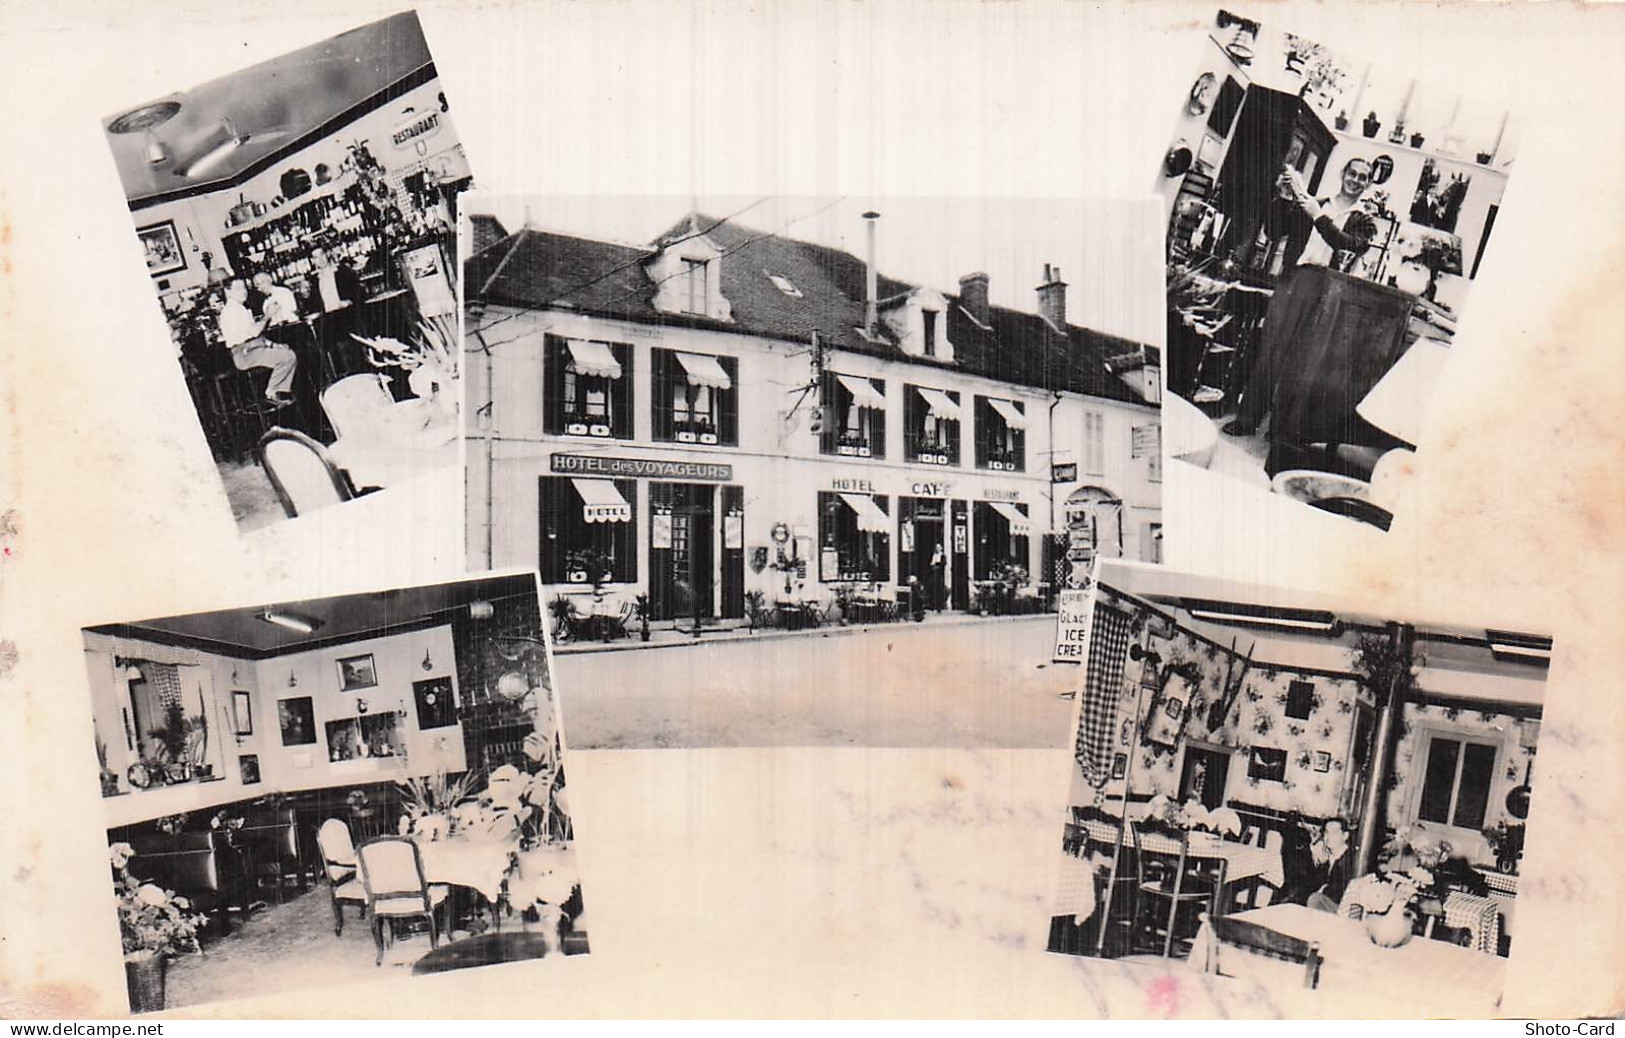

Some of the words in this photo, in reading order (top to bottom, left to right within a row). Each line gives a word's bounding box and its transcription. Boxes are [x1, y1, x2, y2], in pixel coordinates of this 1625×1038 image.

[392, 113, 439, 145] RESTAURANT
[554, 456, 608, 471] HOTEL
[611, 460, 634, 473] des
[634, 461, 729, 477] VOYAGEURS
[832, 478, 875, 492] HOTEL
[587, 507, 627, 516] HOTEL
[1065, 629, 1085, 641] ICE
